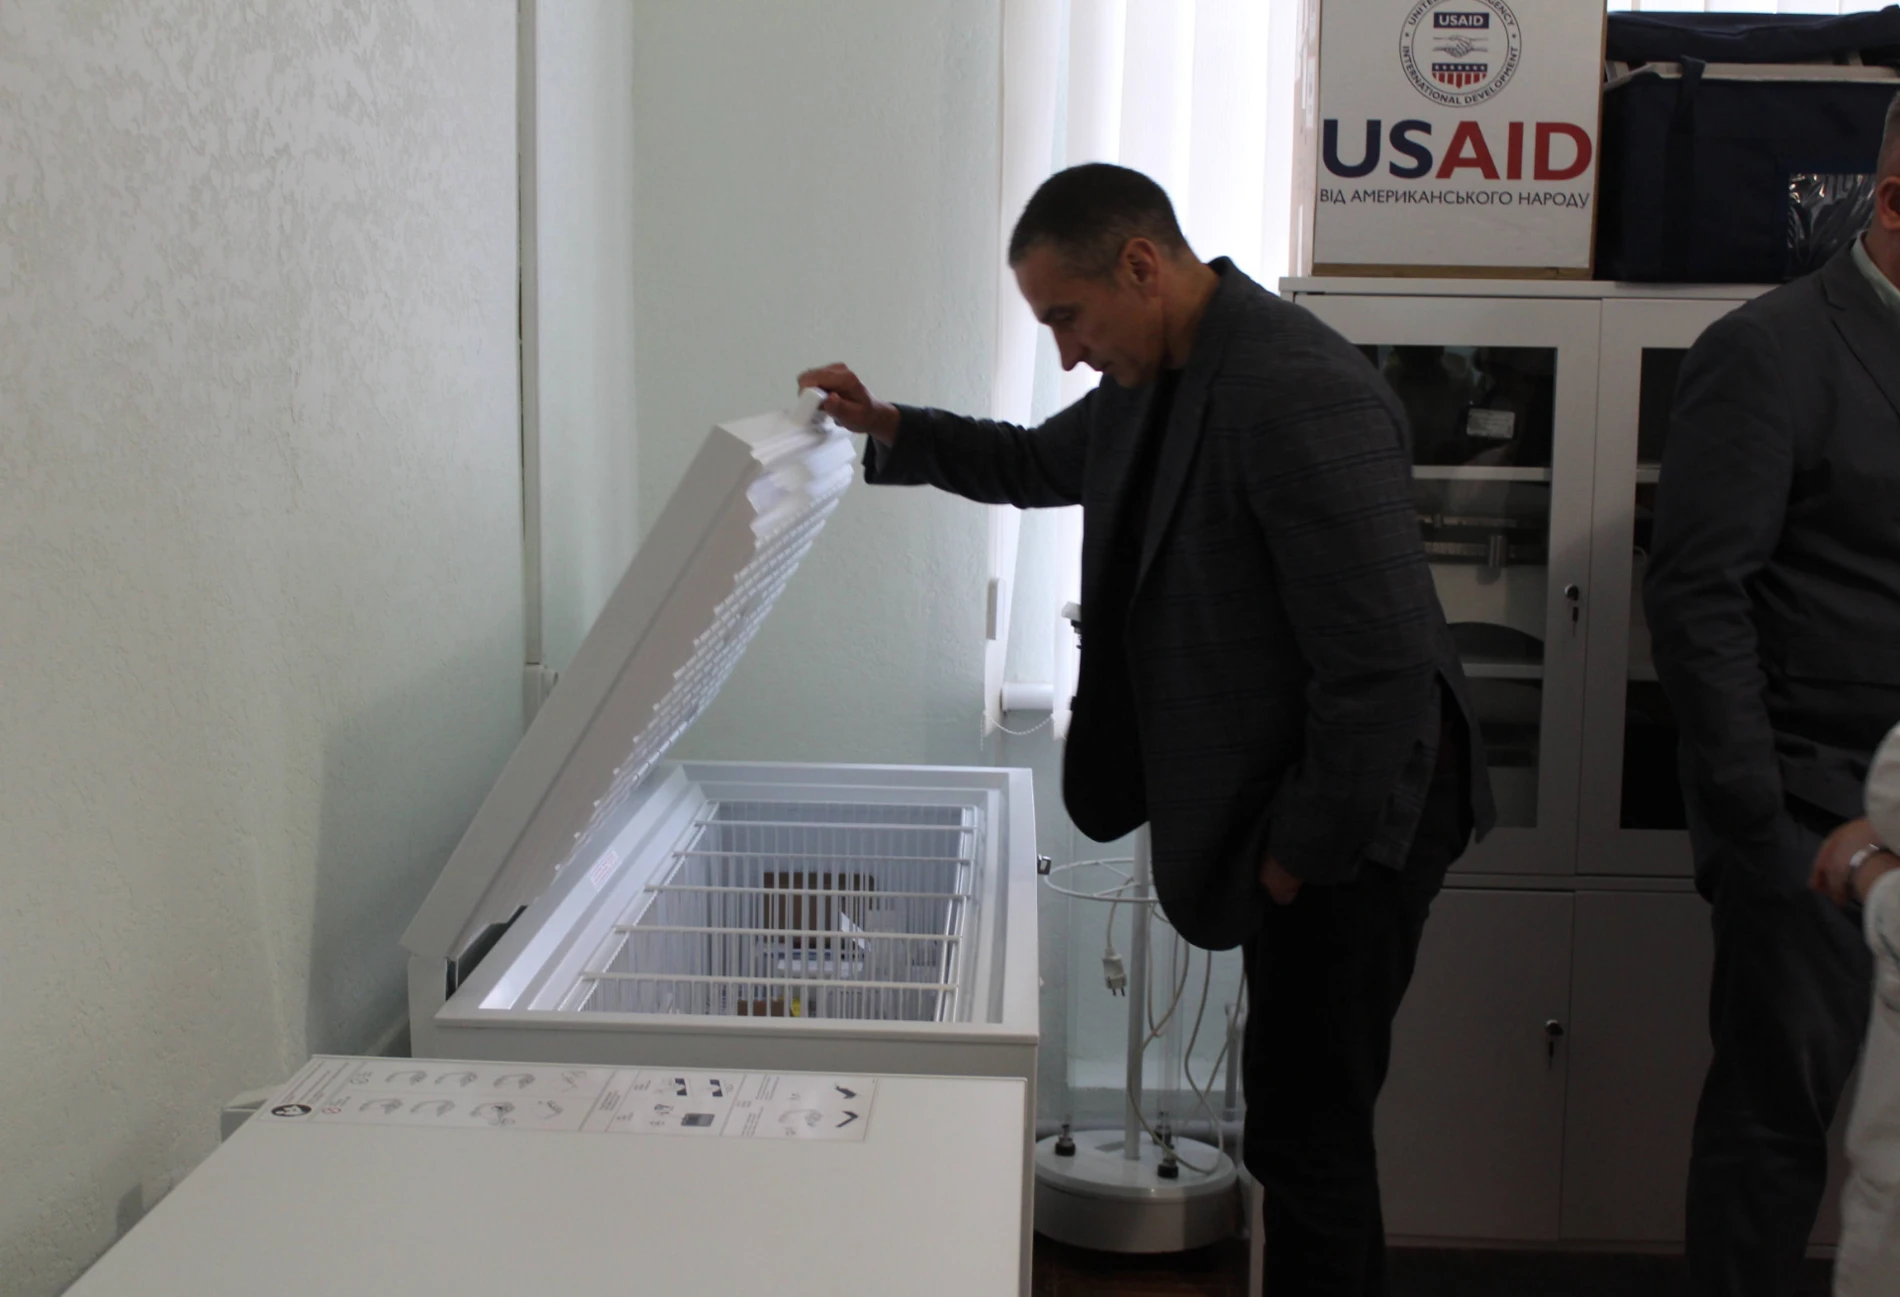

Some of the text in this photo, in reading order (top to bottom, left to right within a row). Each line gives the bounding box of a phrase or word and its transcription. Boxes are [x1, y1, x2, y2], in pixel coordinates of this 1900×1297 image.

[1408, 0, 1437, 25] UNITE
[1439, 15, 1484, 26] USAID
[1403, 46, 1518, 104] INTERNATIONAL DEVELOPMENT
[1322, 119, 1592, 180] USAID
[1320, 189, 1590, 209] ВІД АМЕРИКАНСЬКОГО НАРОДУ
